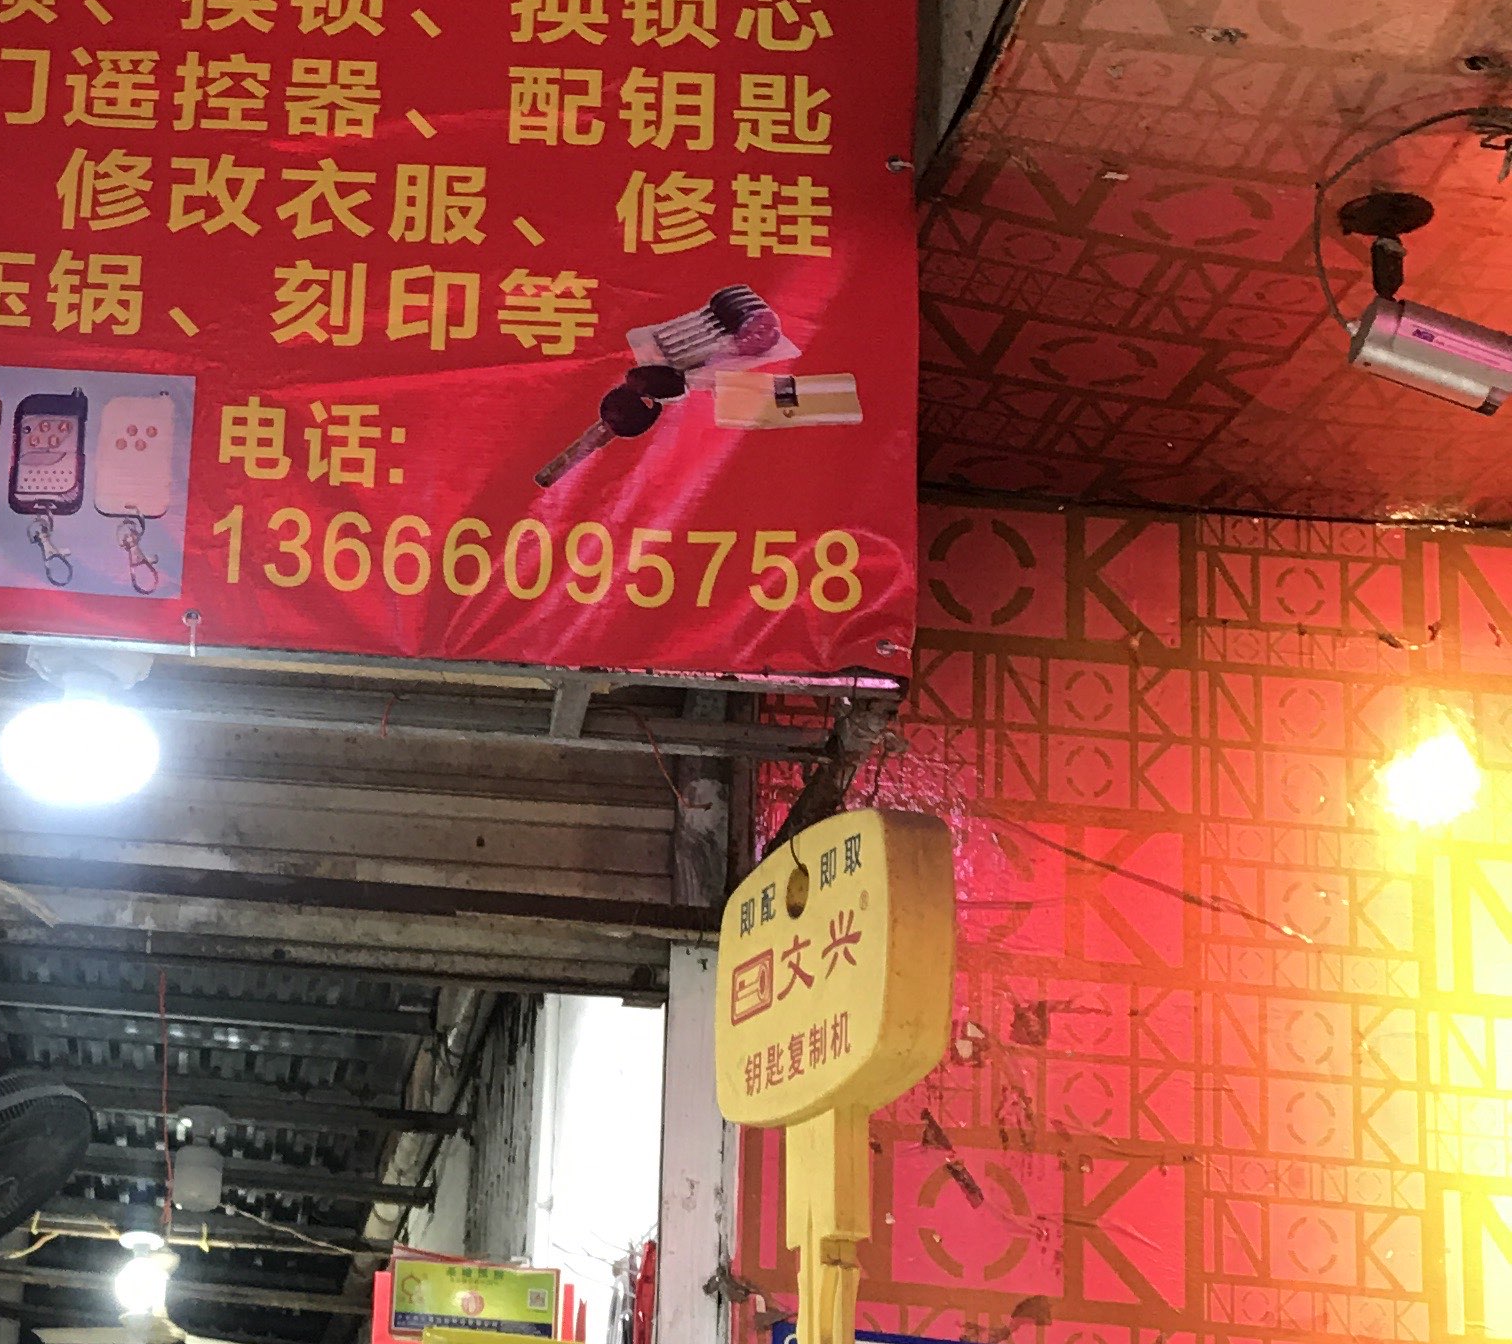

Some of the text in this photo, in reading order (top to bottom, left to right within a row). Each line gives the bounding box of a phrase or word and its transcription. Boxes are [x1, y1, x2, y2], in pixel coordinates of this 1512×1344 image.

[210, 506, 865, 616] 13666095758
[744, 1010, 852, 1098] 钥匙复制机
